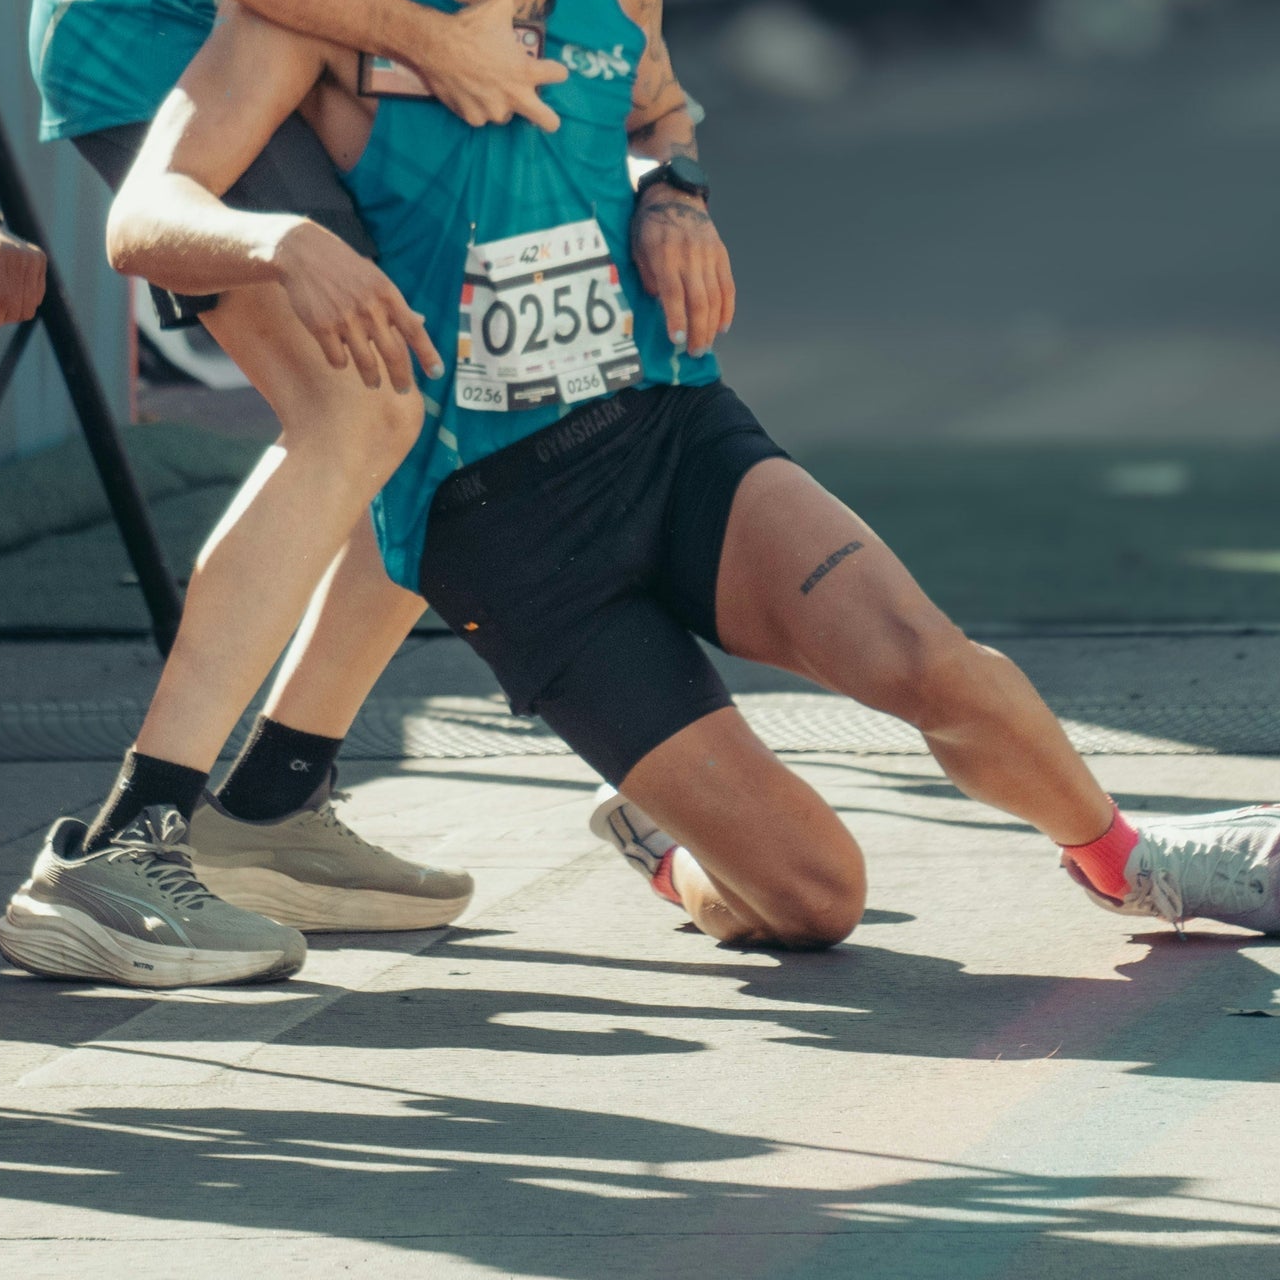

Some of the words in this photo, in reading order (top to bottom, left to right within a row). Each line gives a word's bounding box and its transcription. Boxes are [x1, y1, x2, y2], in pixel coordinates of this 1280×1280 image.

[519, 242, 553, 263] 42K
[482, 278, 616, 357] 0256
[567, 374, 601, 394] 0256
[462, 386, 503, 404] 0256
[535, 396, 628, 464] GYMSHARK
